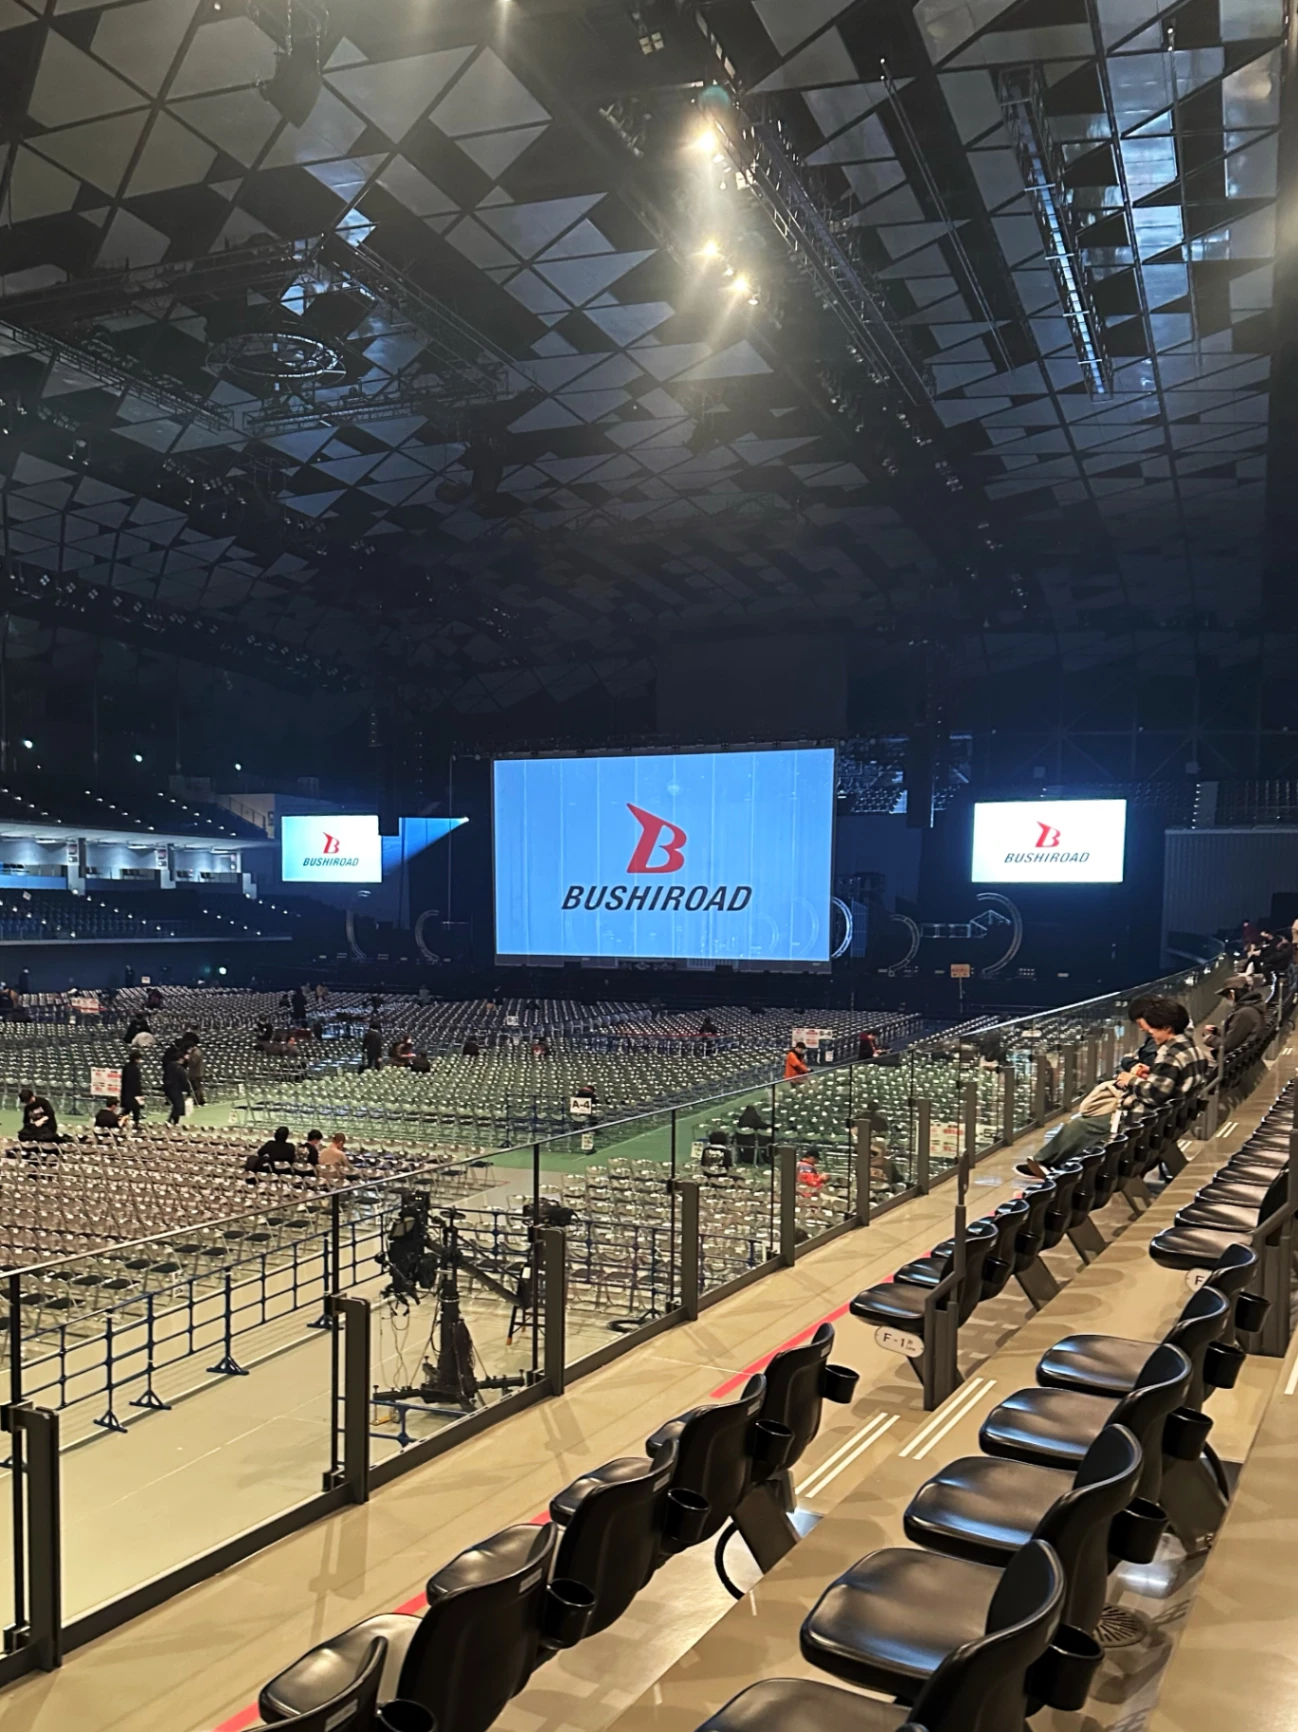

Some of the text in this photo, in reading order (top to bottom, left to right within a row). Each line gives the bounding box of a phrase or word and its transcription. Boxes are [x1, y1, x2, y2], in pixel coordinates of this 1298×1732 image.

[626, 802, 687, 874] B
[303, 858, 359, 866] BUSHIROAD
[1004, 852, 1090, 863] BUSHIROAD
[561, 885, 753, 911] BUSHIROAD
[572, 1100, 590, 1109] A-4
